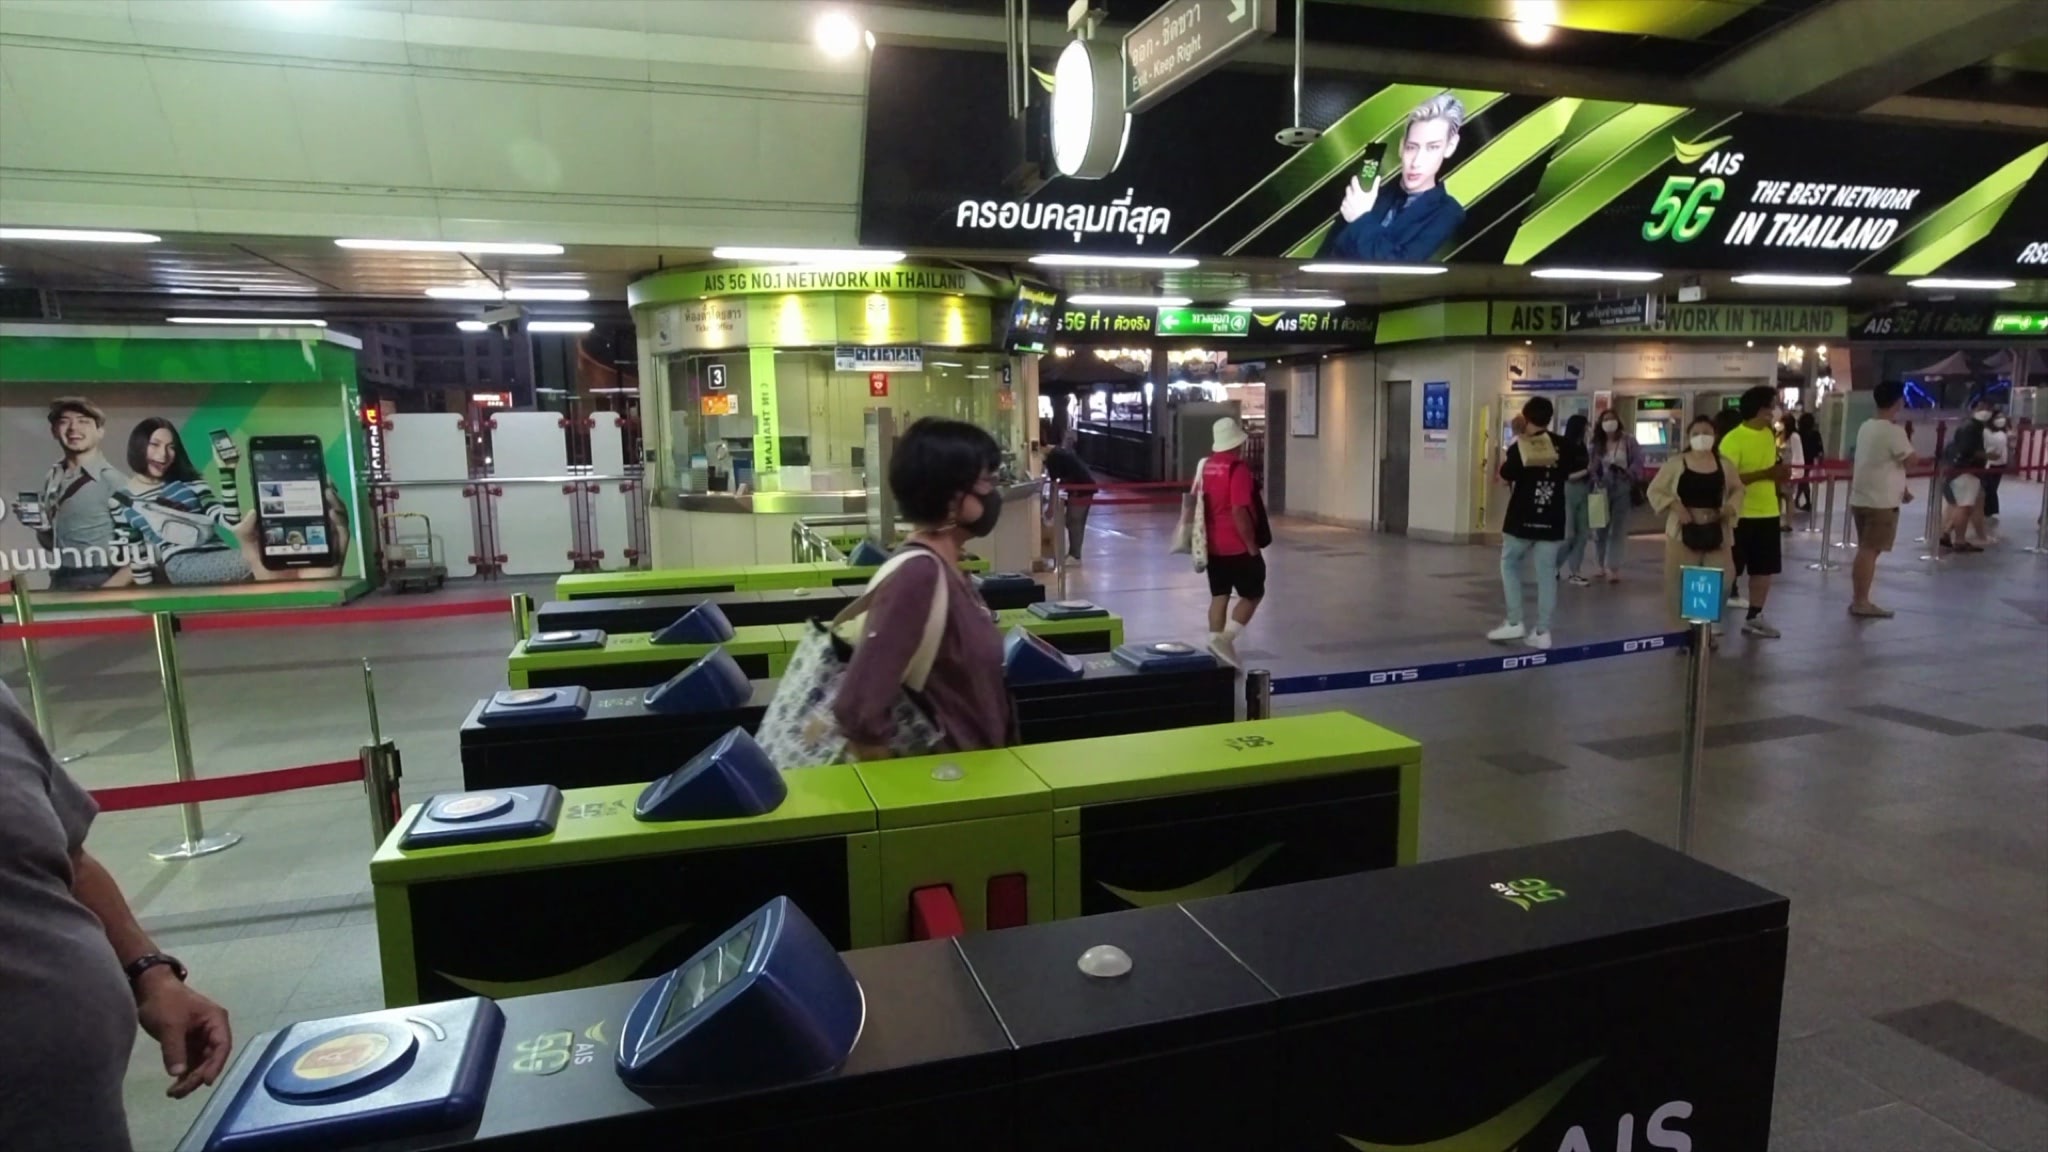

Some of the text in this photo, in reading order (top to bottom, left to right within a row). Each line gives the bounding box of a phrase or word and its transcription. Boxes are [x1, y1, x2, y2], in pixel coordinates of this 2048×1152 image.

[1132, 70, 1148, 92] Exit
[1153, 54, 1176, 79] Keep
[1176, 33, 1202, 63] Right
[1699, 151, 1745, 175] AIS
[1751, 180, 1921, 210] THE BEST NETWORK
[956, 187, 1172, 246] ครอบคลุมที่สุด
[1641, 175, 1726, 243] 5G
[1723, 211, 1899, 251] IN THAILAND
[704, 271, 967, 291] AIS 5G NO.1 NETWORK IN THAILAND
[1064, 312, 1087, 331] 5G
[1103, 316, 1110, 331] 1
[1114, 315, 1151, 332] ตัวจริง
[1275, 319, 1298, 332] AIS
[1299, 313, 1318, 332] 5G
[1511, 304, 1545, 332] AIS
[1725, 309, 1745, 332] IN
[1751, 309, 1834, 333] THAILAND
[1863, 317, 1893, 334] AIS
[713, 369, 723, 385] 3
[1003, 366, 1011, 382] 2
[1623, 636, 1665, 652] BTS
[1502, 653, 1548, 669] BTS
[1369, 668, 1419, 684] BTS
[574, 1043, 596, 1065] AIS
